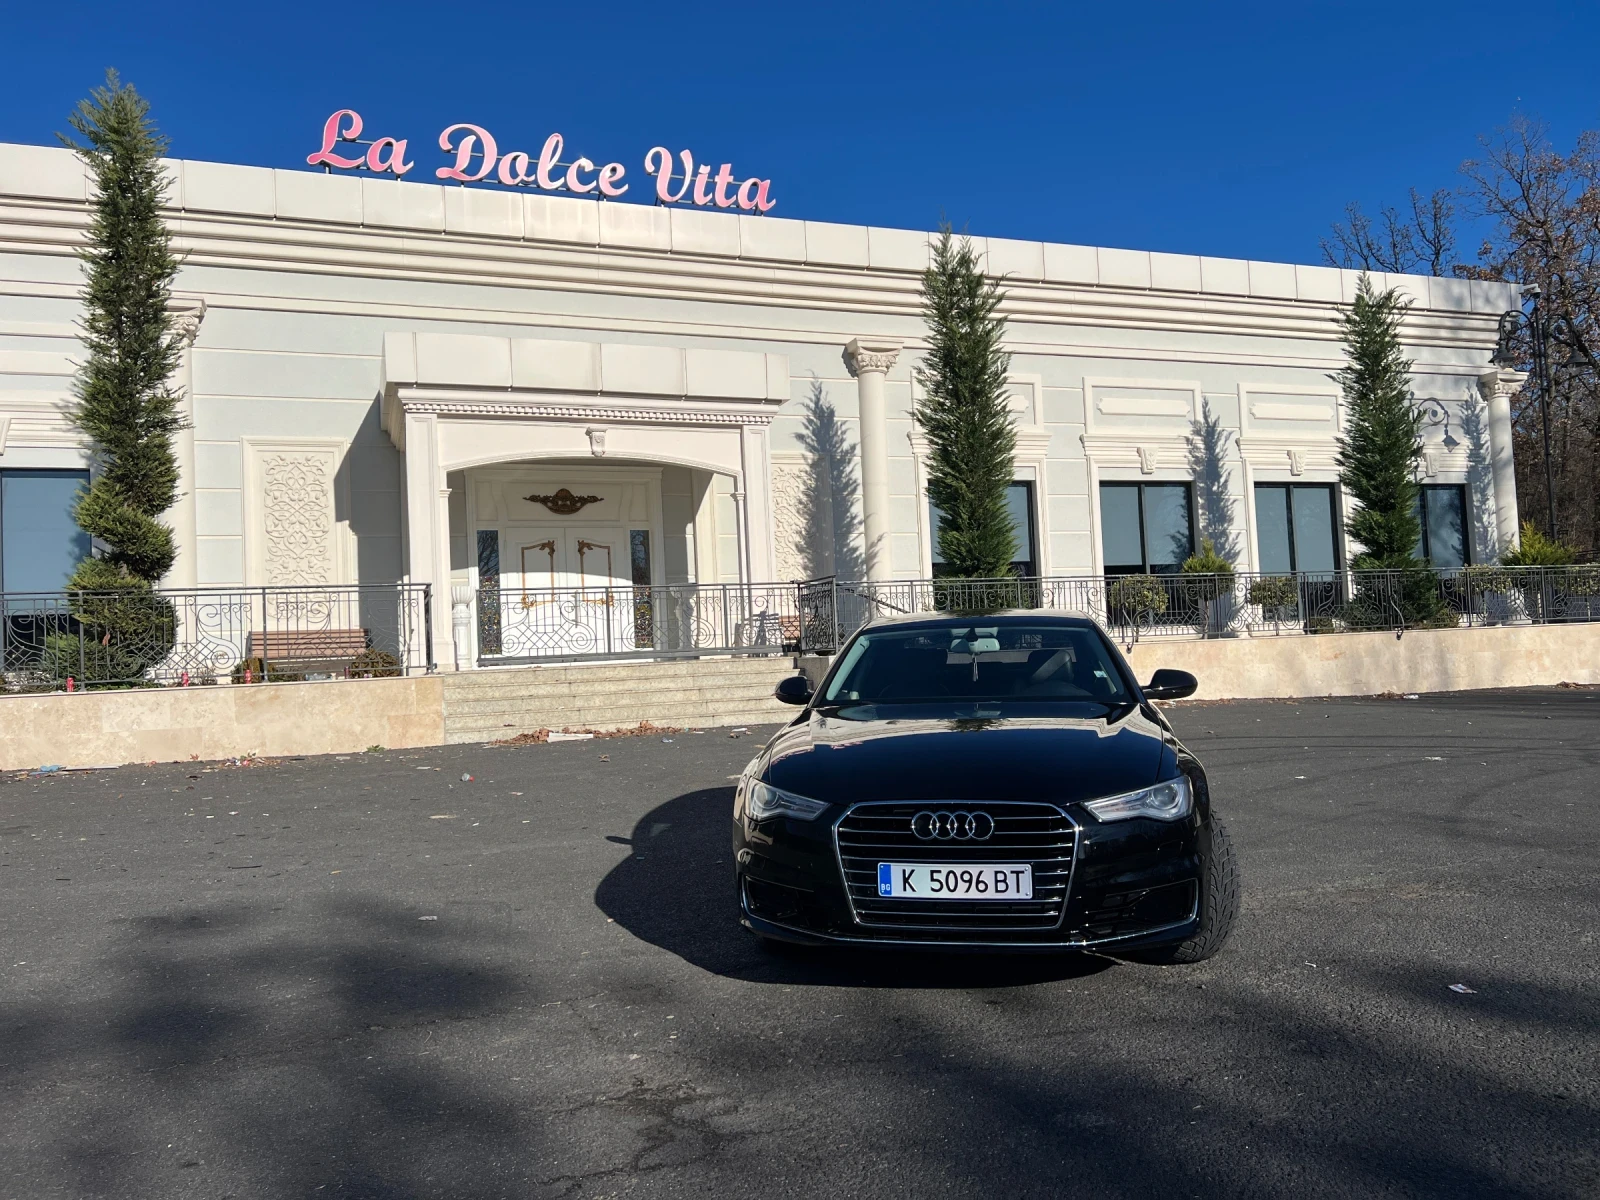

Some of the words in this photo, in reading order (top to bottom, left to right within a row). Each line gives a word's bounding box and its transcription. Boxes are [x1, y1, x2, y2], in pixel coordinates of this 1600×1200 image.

[306, 109, 415, 175] La
[435, 123, 630, 197] Dolce
[644, 146, 777, 212] Vita
[903, 869, 916, 892] K
[929, 869, 988, 893] 5096
[994, 870, 1025, 893] BT
